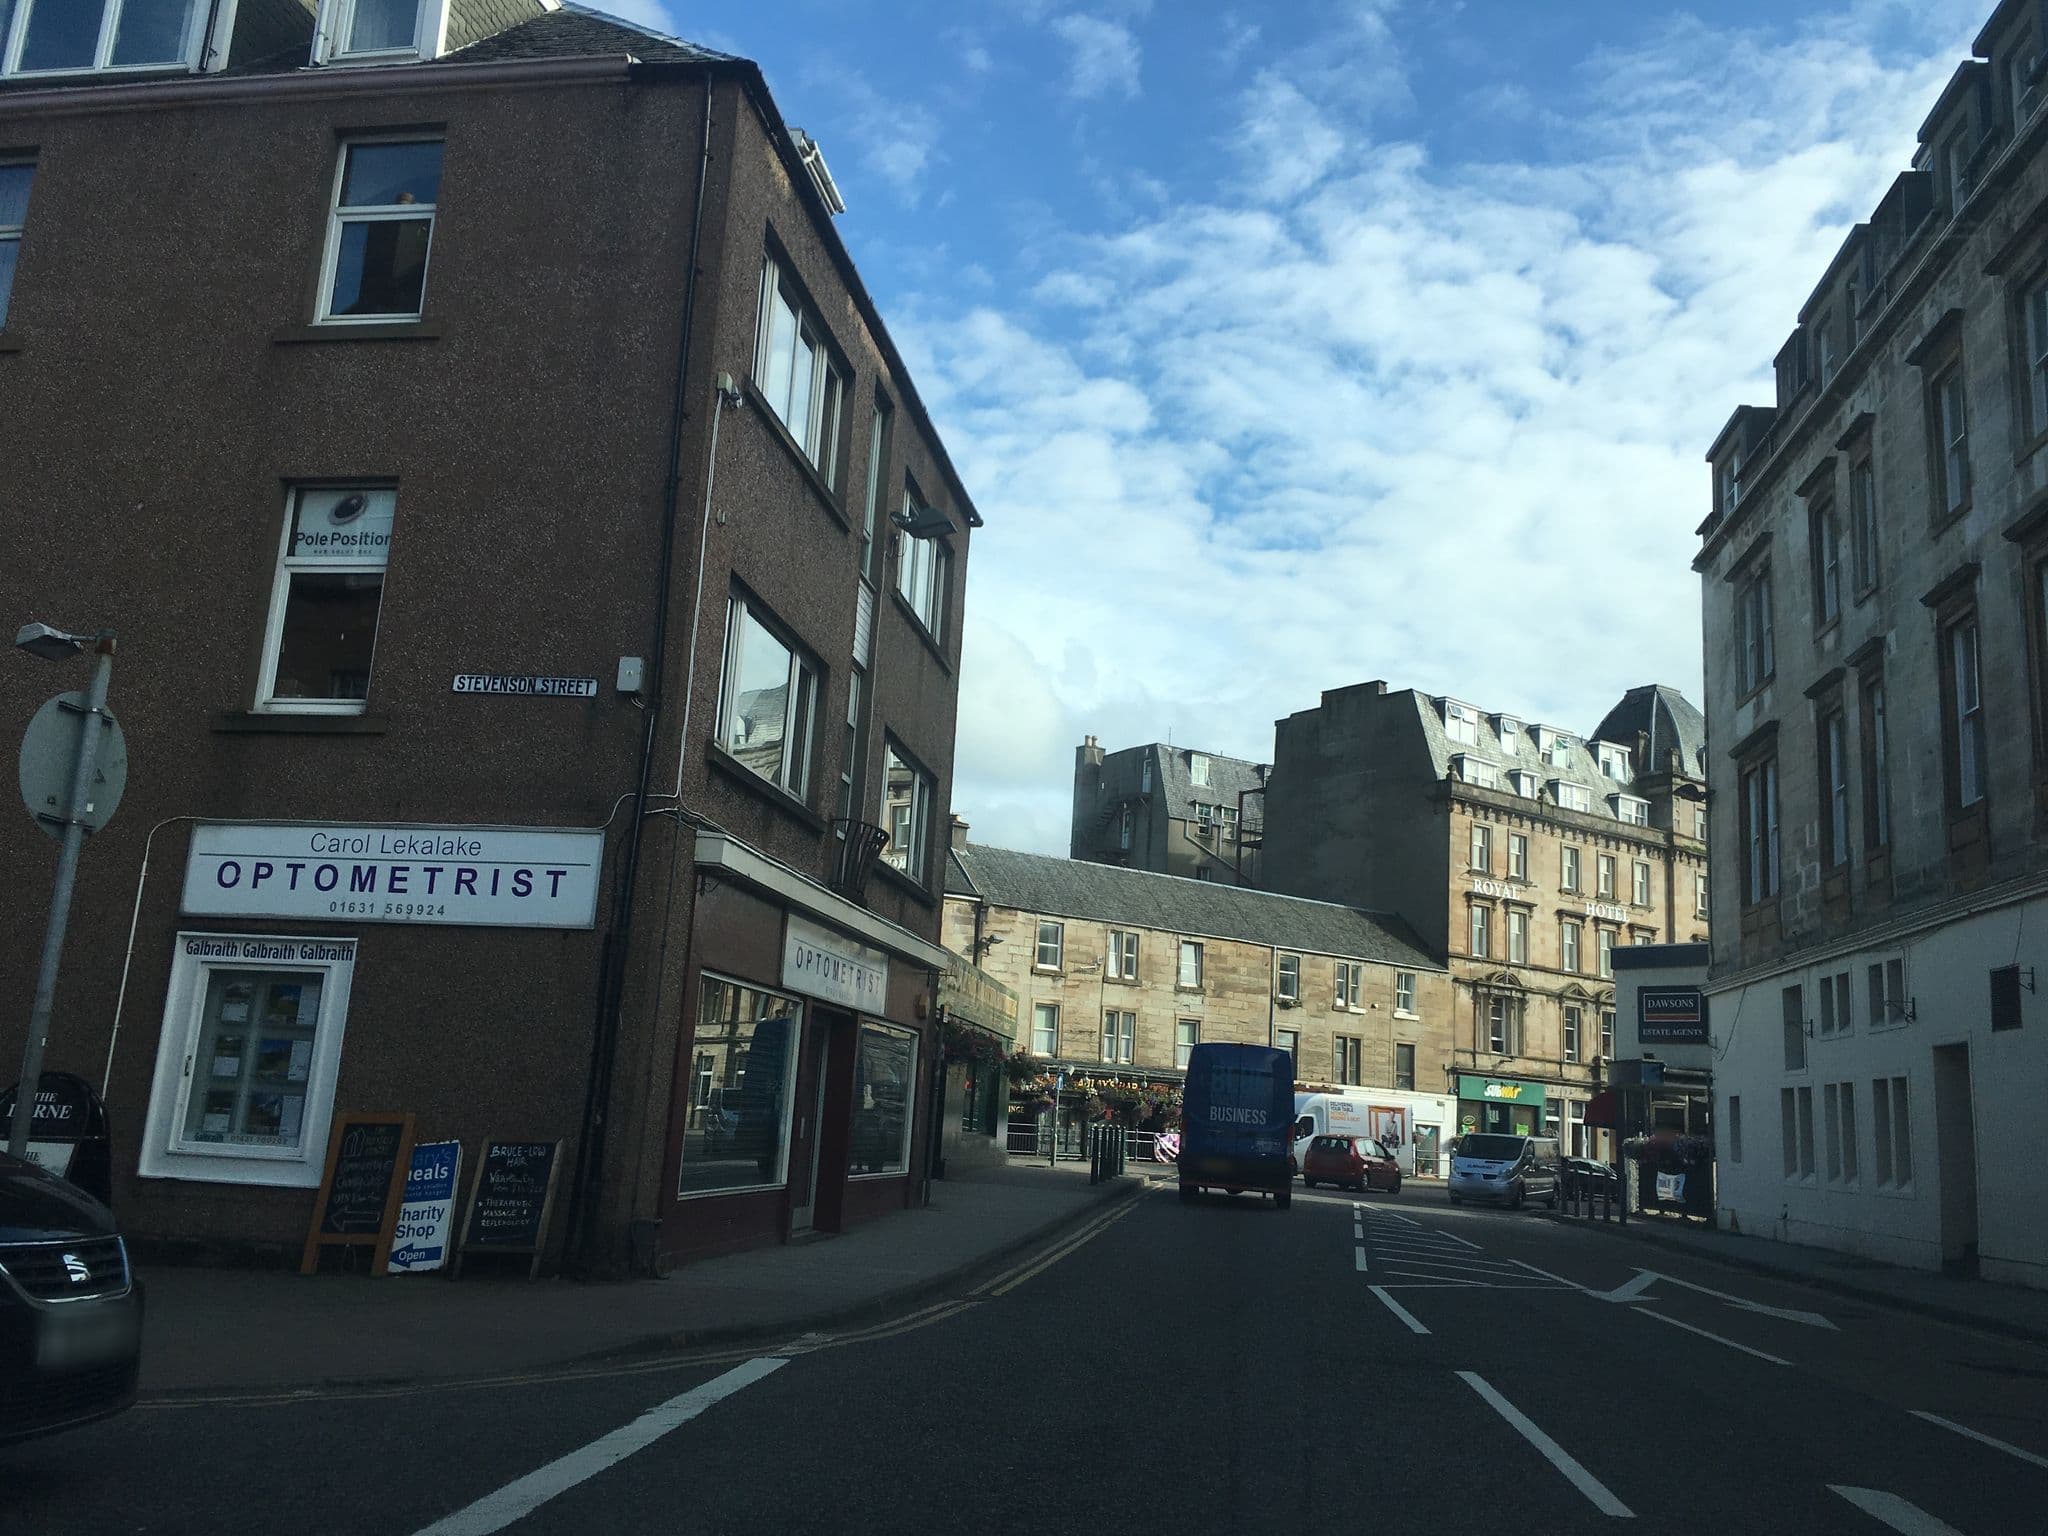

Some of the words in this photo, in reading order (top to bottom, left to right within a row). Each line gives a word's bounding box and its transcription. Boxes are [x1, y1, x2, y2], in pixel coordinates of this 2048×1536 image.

[295, 532, 329, 546] Pole
[457, 675, 536, 694] STEVENSON
[540, 678, 594, 696] STREET
[309, 832, 370, 856] Carol
[379, 834, 482, 857] Lekalake
[216, 860, 568, 899] OPTOMETRIST
[1472, 878, 1520, 901] ROYAL
[328, 901, 376, 914] 01631
[384, 901, 447, 917] 569924
[1584, 902, 1631, 923] HOTEL
[185, 939, 238, 958] Galbraith
[242, 942, 295, 960] Galbraith
[299, 944, 354, 962] Galbraith
[795, 945, 882, 995] OPTOMETRIST
[1647, 998, 1695, 1009] DAWSONS
[1642, 1028, 1671, 1037] ESTATE
[1673, 1028, 1703, 1037] AGENTS
[1483, 1084, 1523, 1099] SUBWAY
[6, 1103, 73, 1120] LRNE
[1209, 1105, 1267, 1126] BUSINESS
[24, 1151, 40, 1162] HE
[412, 1147, 452, 1168] ary's
[400, 1205, 446, 1223] harity
[395, 1224, 435, 1240] Shop
[398, 1249, 426, 1263] Open
